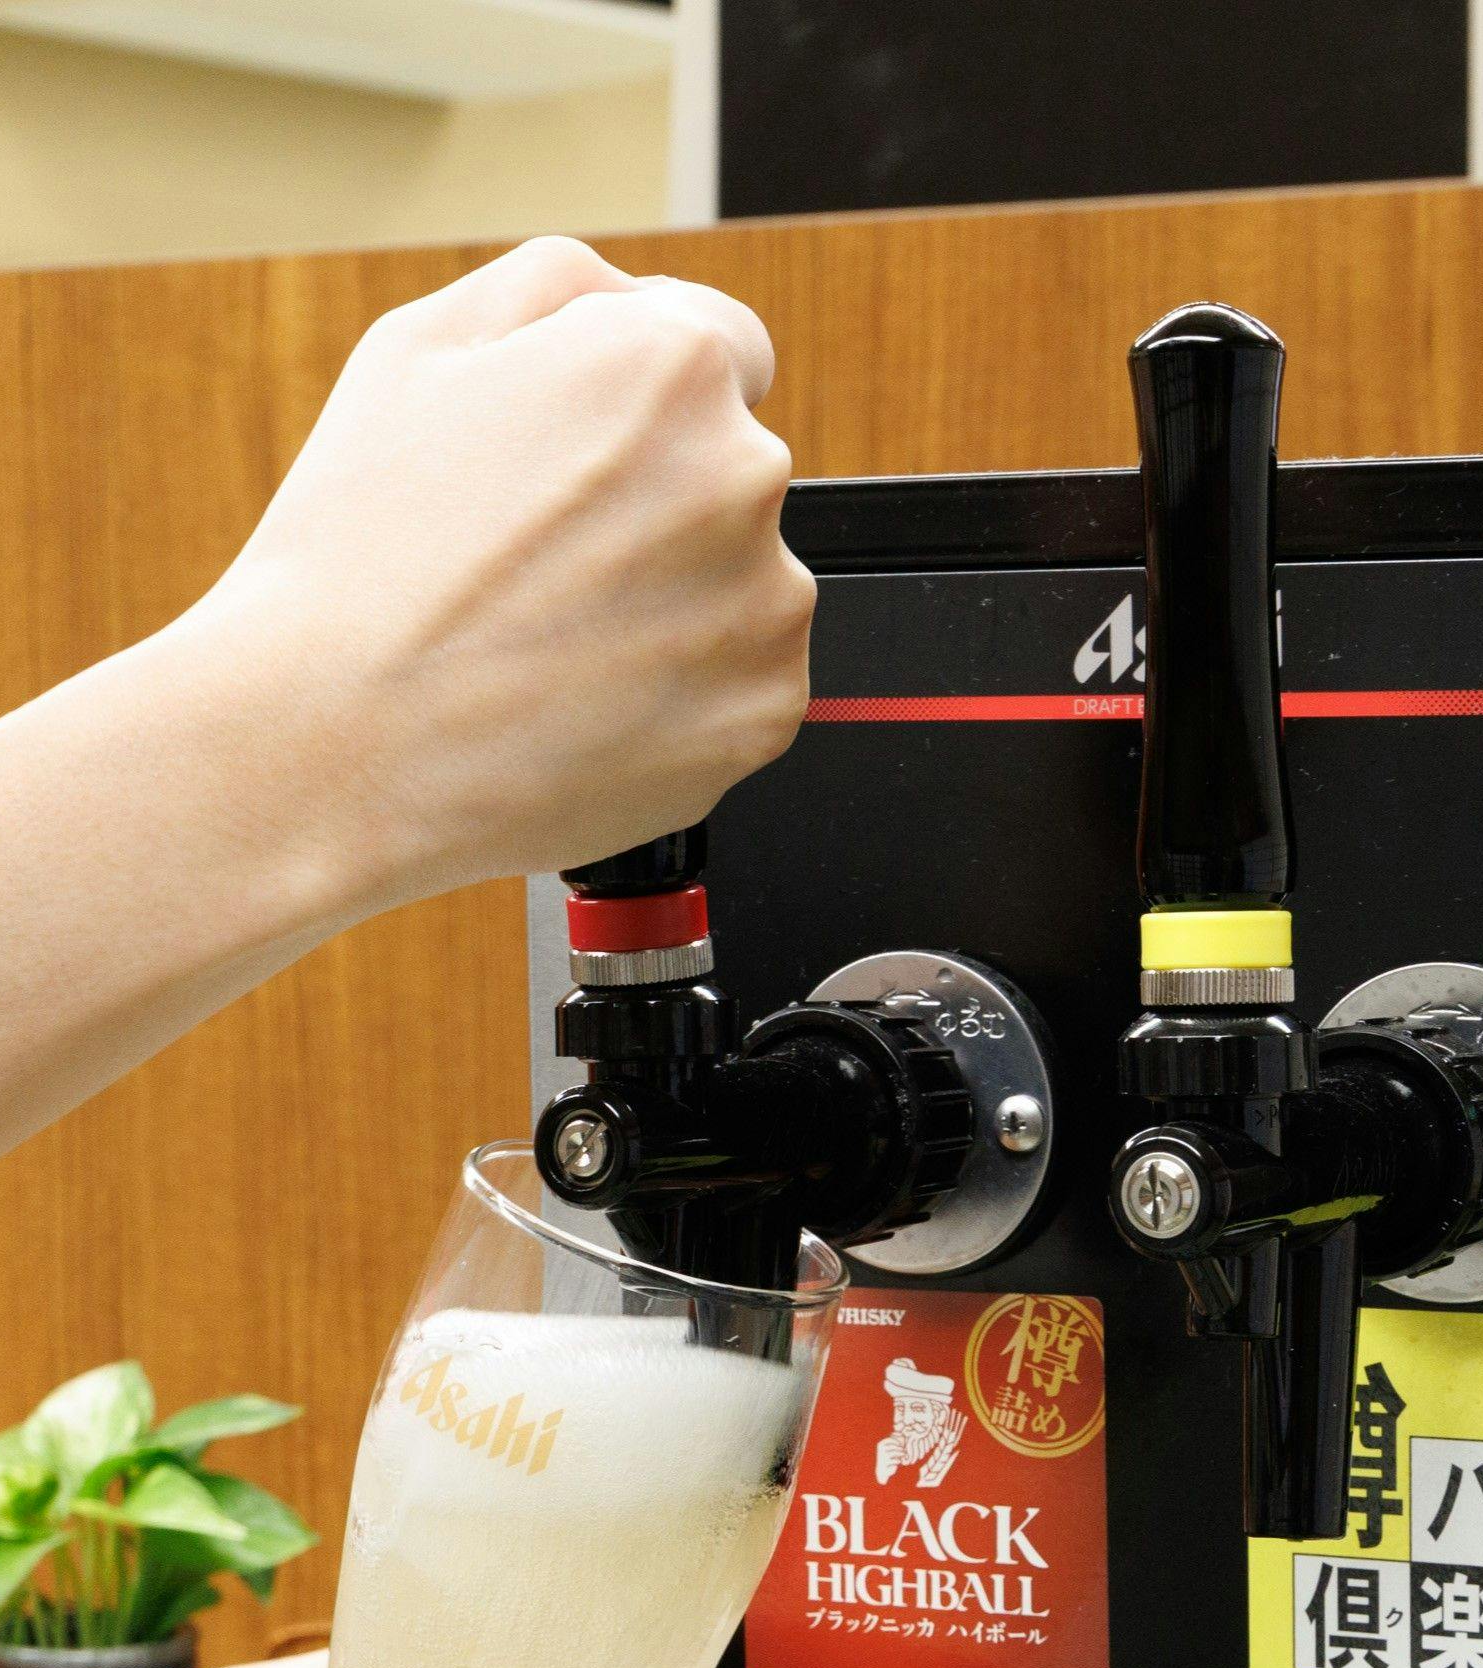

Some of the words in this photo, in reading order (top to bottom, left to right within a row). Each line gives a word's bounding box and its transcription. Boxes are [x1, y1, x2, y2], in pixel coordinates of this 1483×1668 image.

[1074, 698, 1134, 715] DRAFT
[1001, 1296, 1091, 1396] 樽
[400, 1354, 566, 1477] Asahi
[988, 1384, 1069, 1441] 詰め
[801, 1494, 1050, 1569] BLACK
[806, 1561, 1051, 1618] HIGHBALL
[806, 1609, 937, 1640] ブラックニッカ
[947, 1620, 1049, 1647] ハイボール
